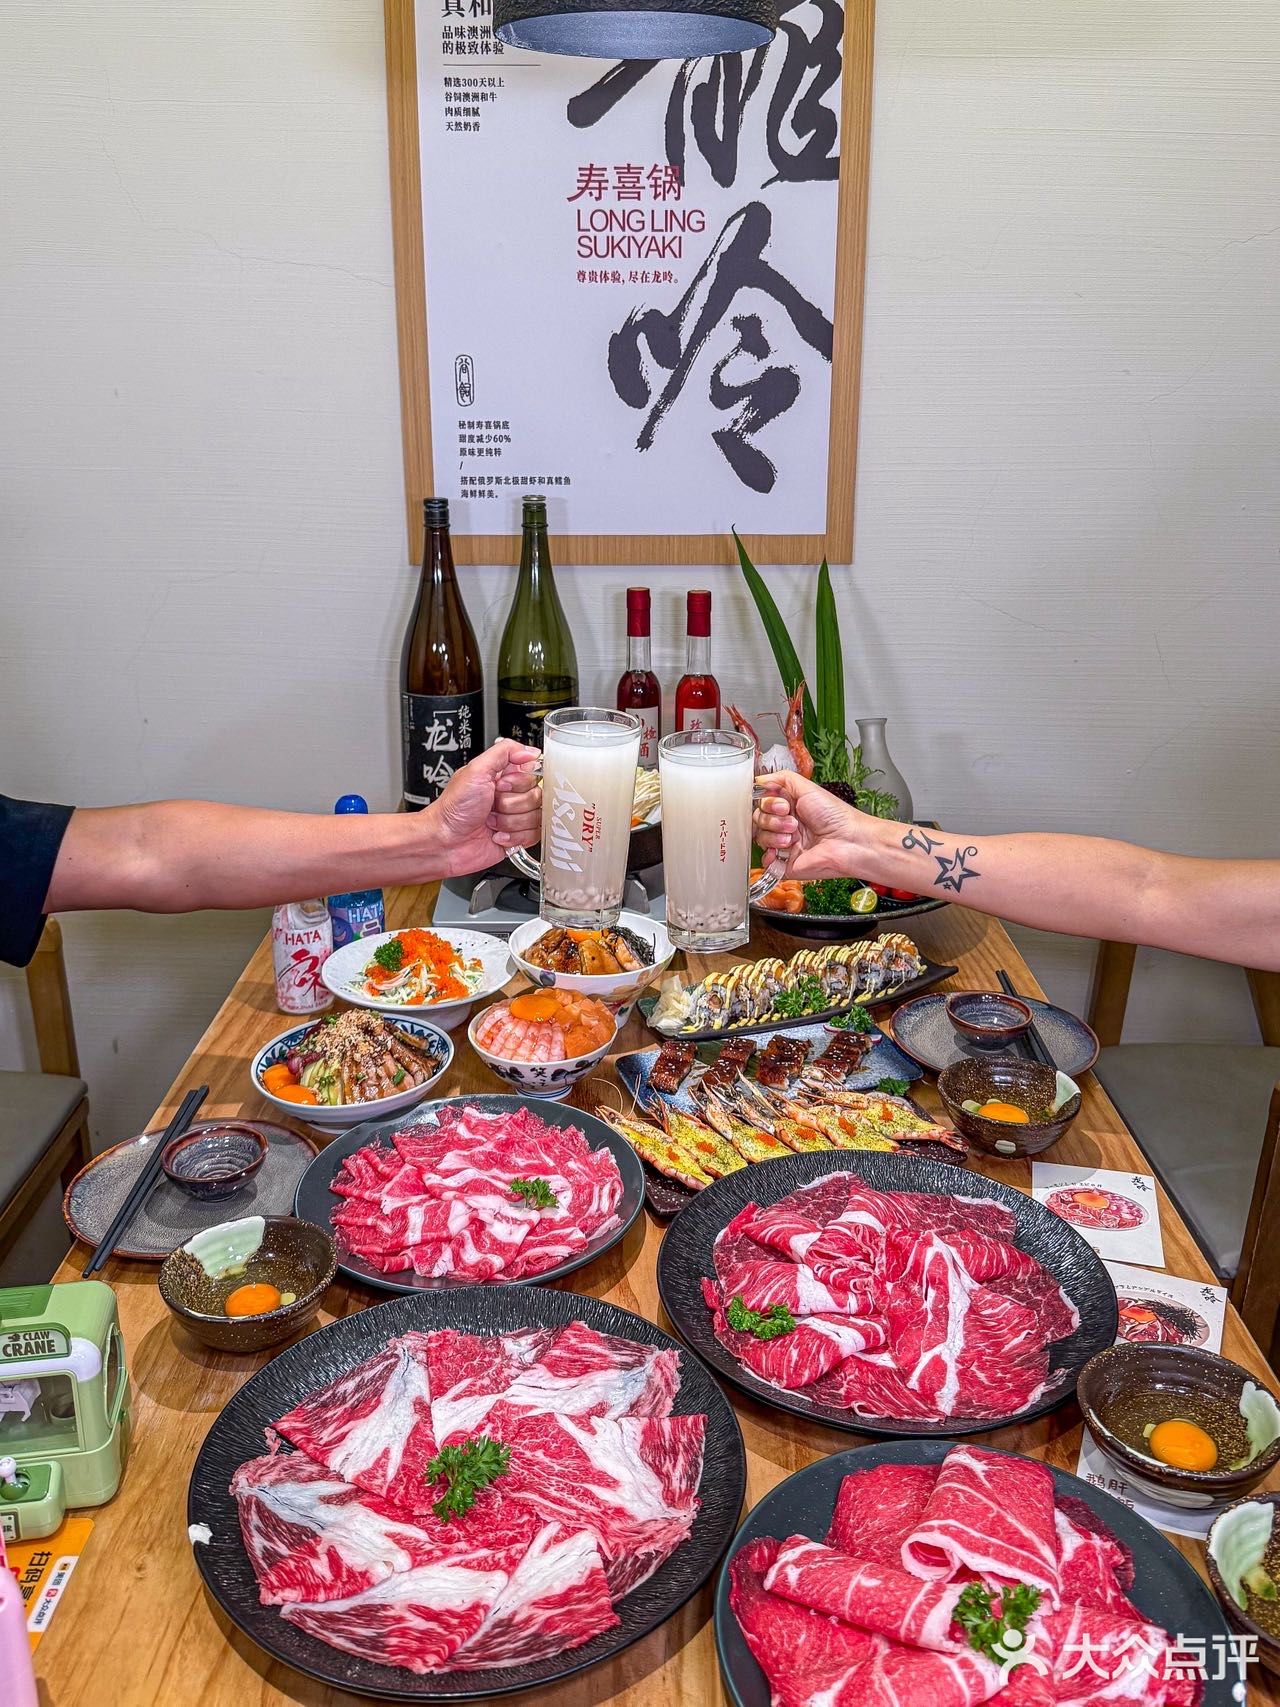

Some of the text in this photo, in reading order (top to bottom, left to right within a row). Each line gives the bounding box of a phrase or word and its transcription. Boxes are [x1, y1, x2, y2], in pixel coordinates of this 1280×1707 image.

[442, 25, 498, 40] 品味澳洲
[442, 40, 505, 55] 的极致体验
[443, 77, 505, 88] 精选300天以上
[444, 91, 498, 103] 谷饲澳洲和牛
[444, 106, 481, 117] 肉质细腻
[445, 121, 481, 132] 天然奶香
[566, 163, 682, 202] 寿喜锅
[576, 208, 706, 233] LONG LING
[576, 235, 682, 259] SUKIYAKI
[458, 420, 510, 430] 秘制寿喜锅底
[458, 434, 512, 444] 甜度减少60%
[459, 448, 502, 457] 原味更纯粹
[460, 476, 571, 486] 搭配俄罗斯北极甜虾和真鳕鱼
[461, 489, 500, 499] 海鲜鲜美。
[549, 771, 587, 873] Asahi
[719, 819, 728, 863] スーパードライ
[285, 930, 322, 945] HATA
[23, 1331, 50, 1341] CLAW
[2, 1339, 56, 1357] CRANE
